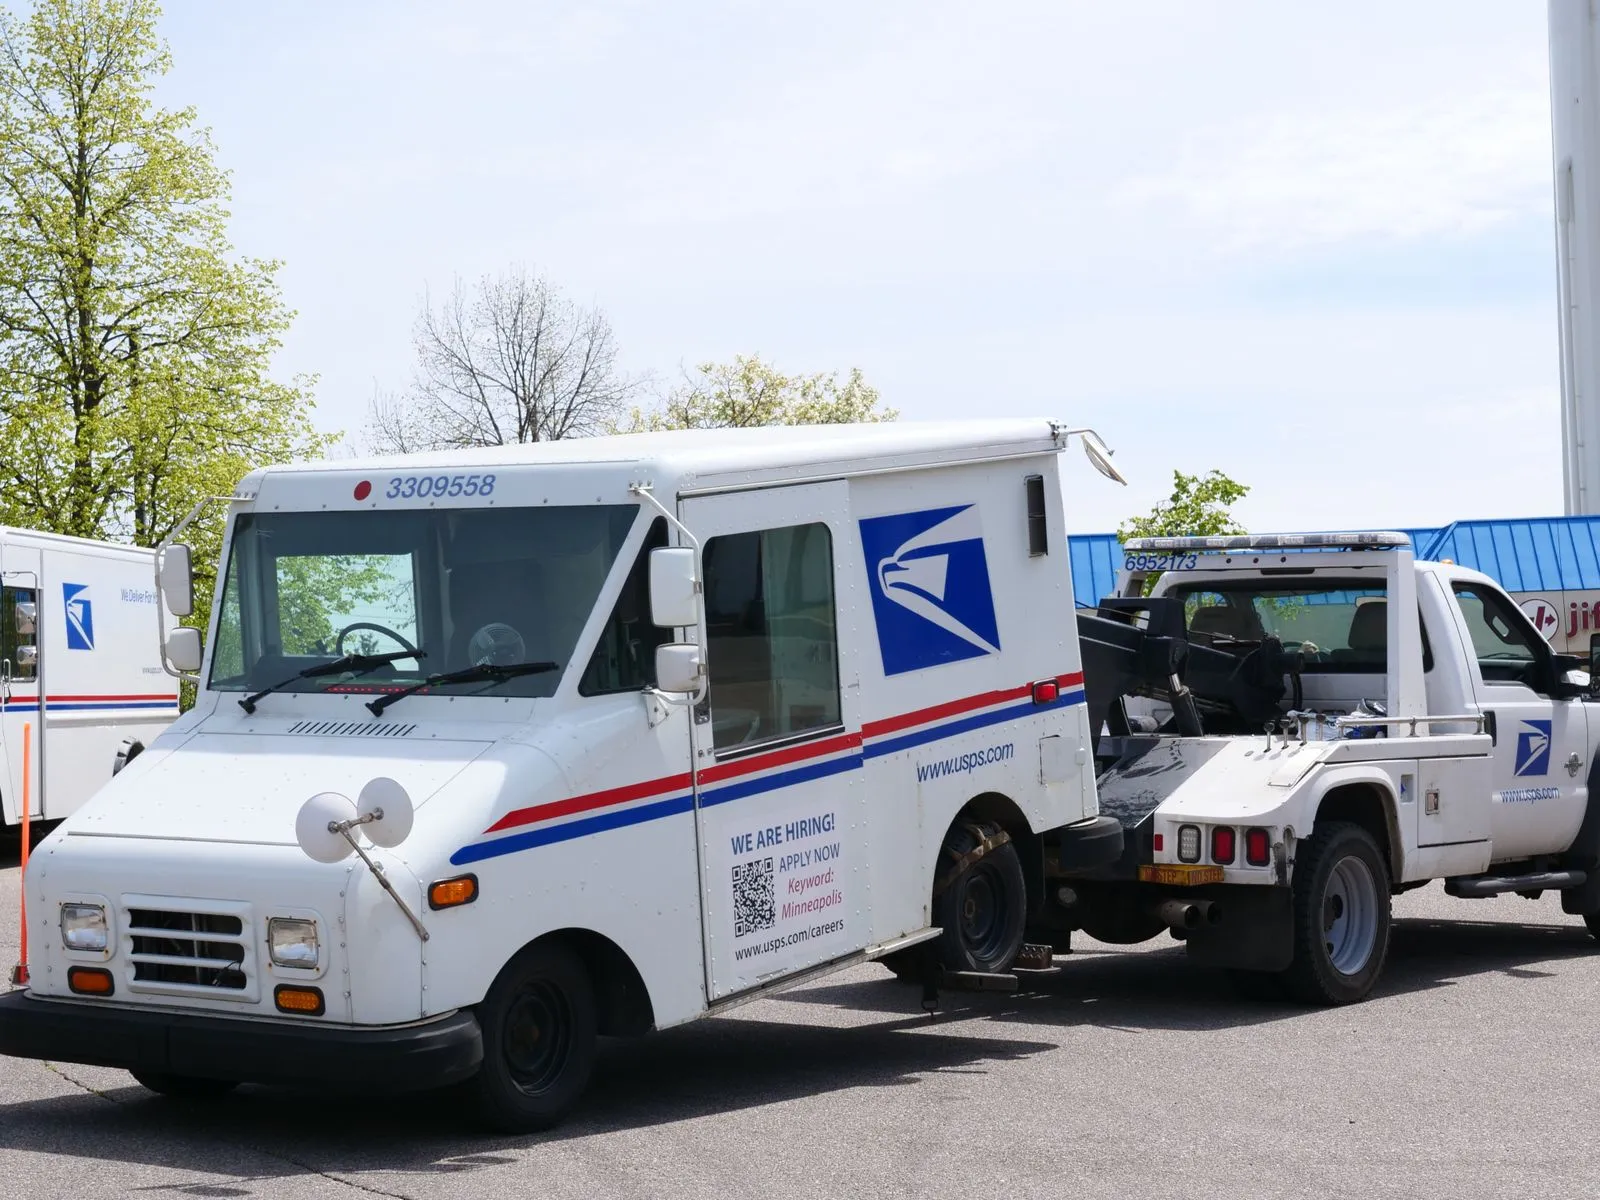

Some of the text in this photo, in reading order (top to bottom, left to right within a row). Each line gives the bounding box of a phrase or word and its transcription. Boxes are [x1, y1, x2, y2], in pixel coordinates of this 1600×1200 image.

[386, 474, 496, 499] 3309558
[1125, 554, 1198, 571] 6952173
[121, 589, 129, 601] We
[129, 589, 144, 602] Deliver
[145, 591, 153, 604] For
[917, 743, 1014, 783] www.usps.com
[1500, 787, 1560, 804] www.usps.com
[731, 812, 835, 855] WE ARE HIRING!
[779, 842, 840, 873] APPLY NOW
[788, 867, 834, 895] Keyword:
[1158, 870, 1177, 884] STEP
[1191, 870, 1202, 884] NO
[781, 889, 842, 920] Minneapolis
[735, 918, 844, 961] www.usps.com/careers
